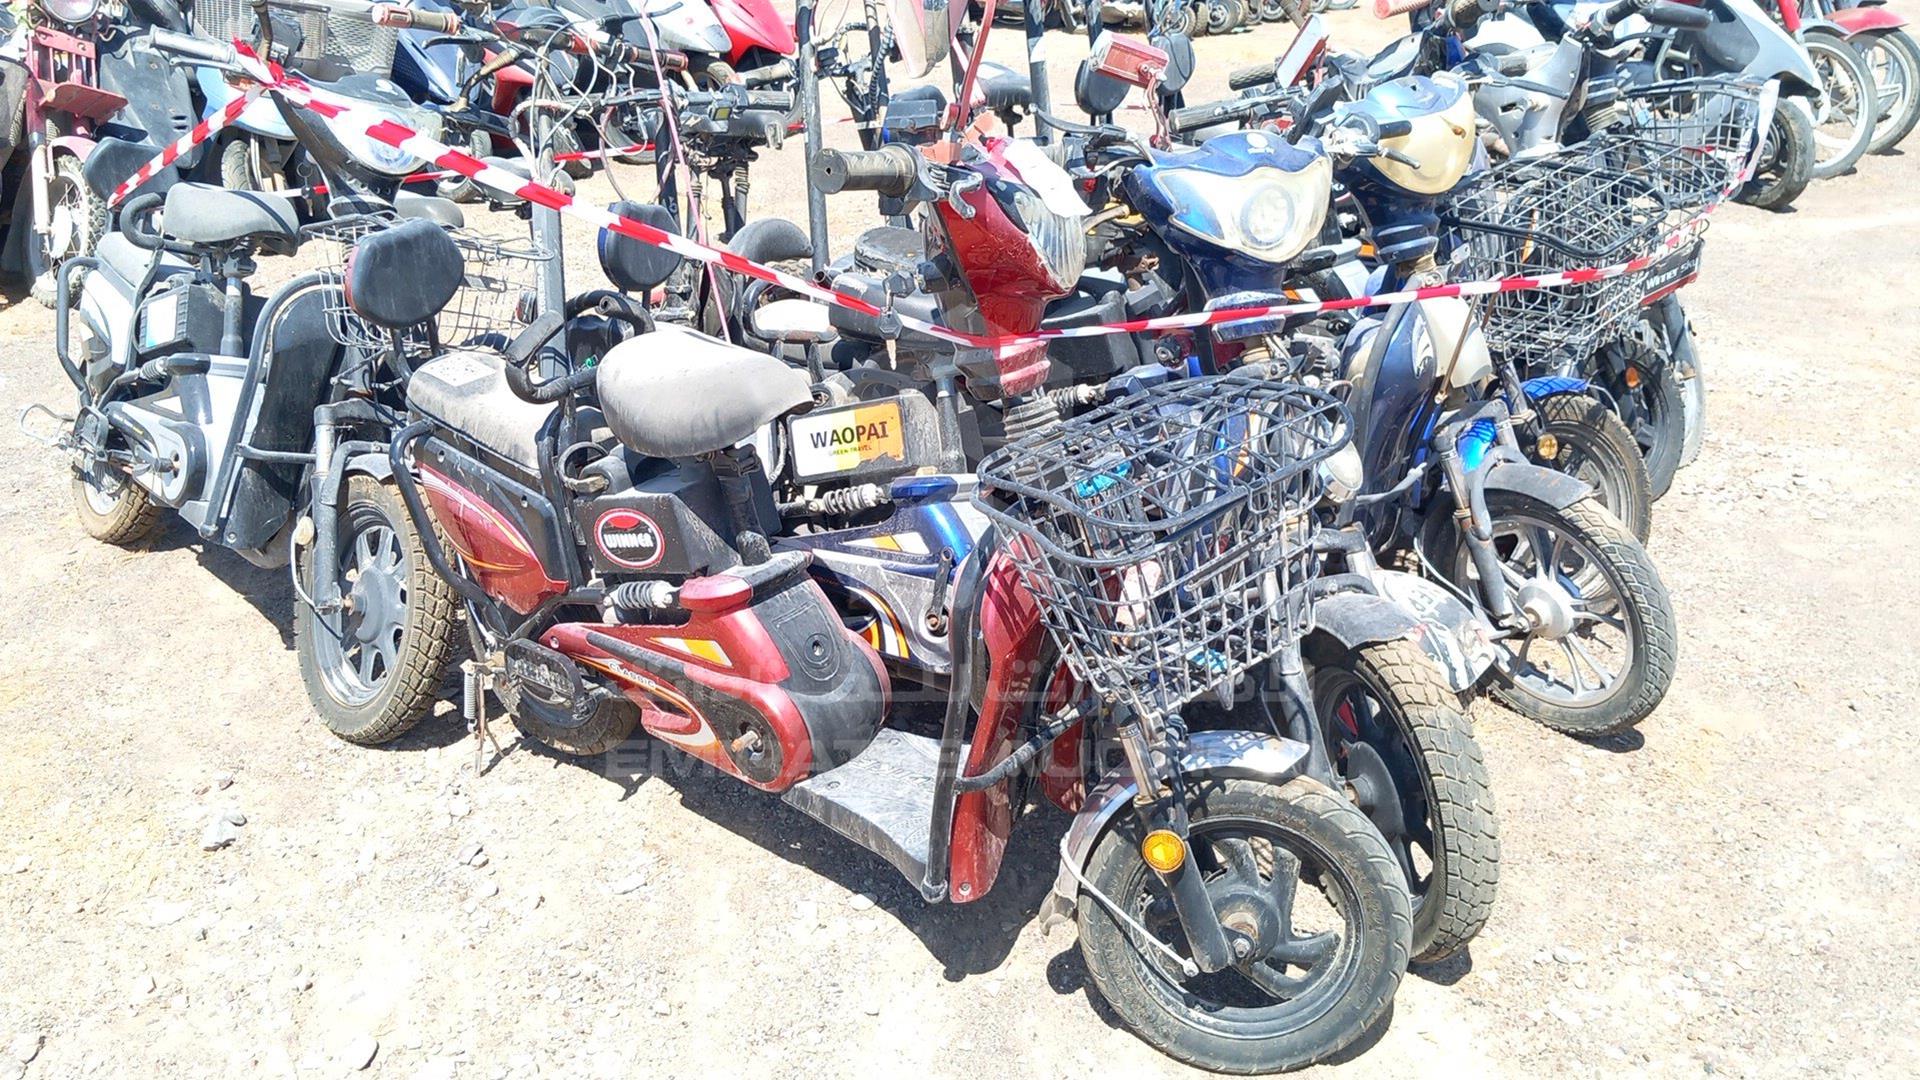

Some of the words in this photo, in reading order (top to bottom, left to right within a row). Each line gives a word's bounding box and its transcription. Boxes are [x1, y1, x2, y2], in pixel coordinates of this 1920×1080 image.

[810, 421, 889, 449] WAOPAI
[850, 444, 873, 453] TRAVEL
[603, 532, 654, 548] WINNER
[608, 661, 657, 690] CLASSIC
